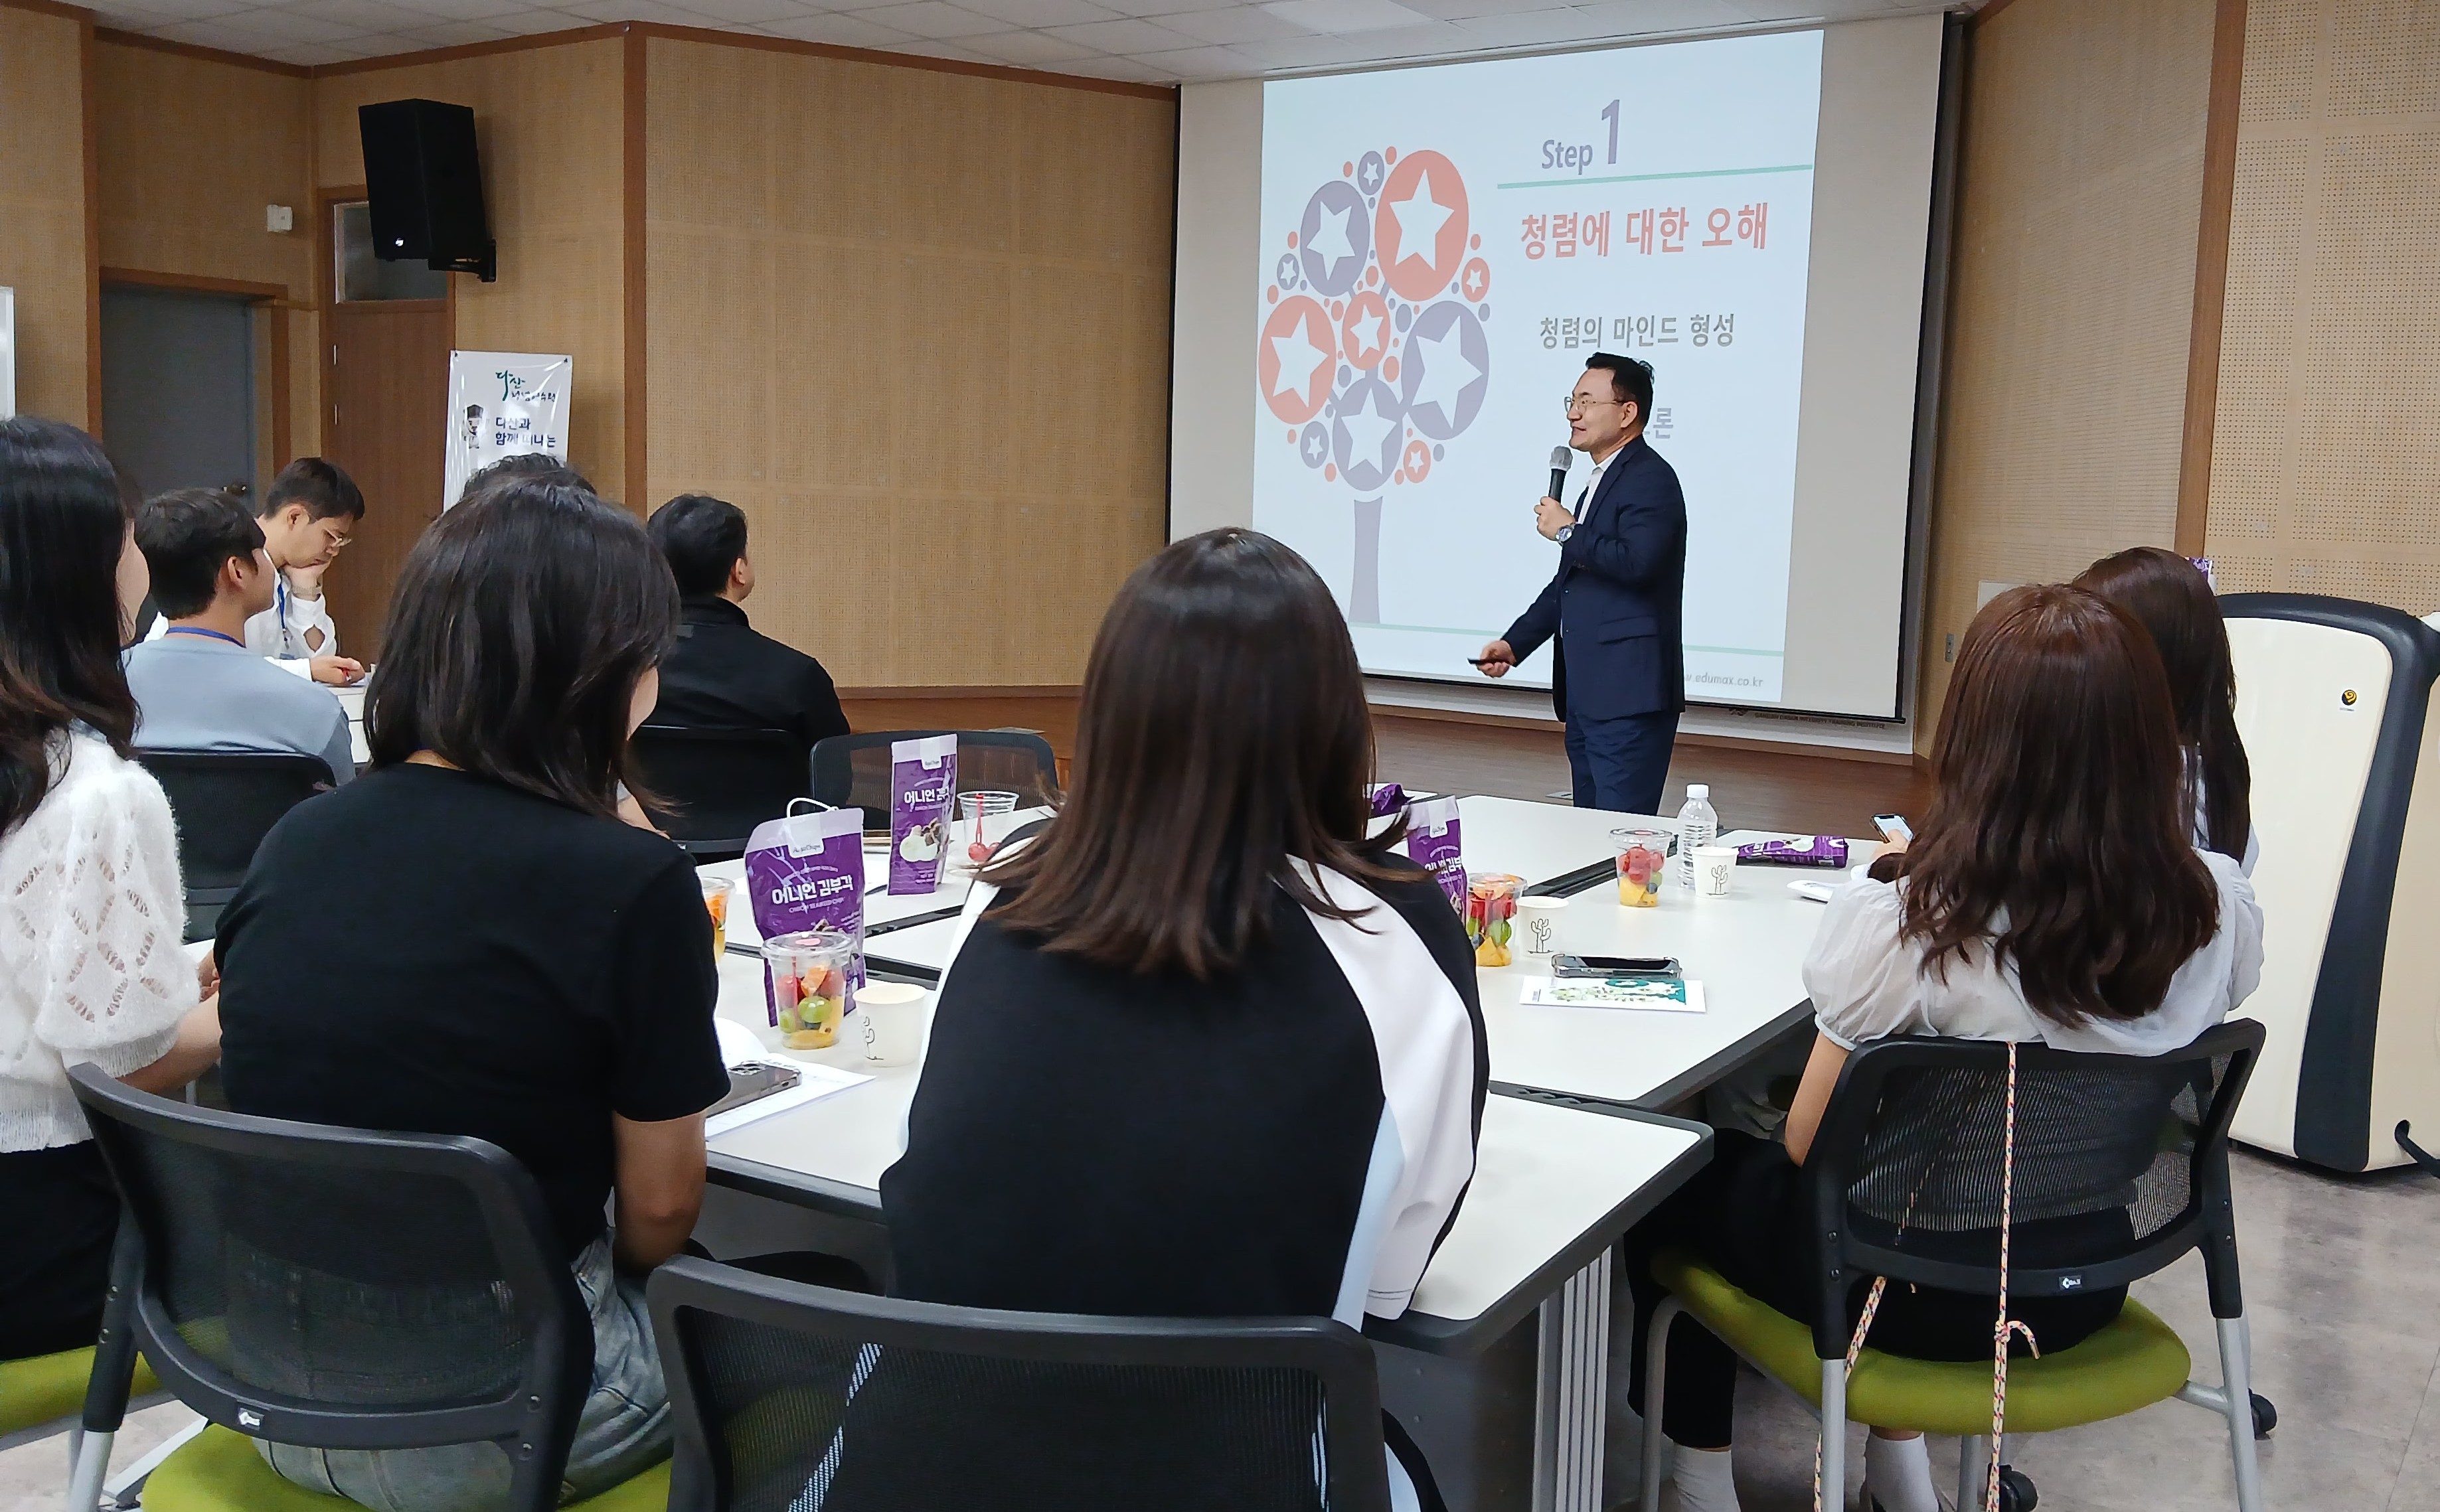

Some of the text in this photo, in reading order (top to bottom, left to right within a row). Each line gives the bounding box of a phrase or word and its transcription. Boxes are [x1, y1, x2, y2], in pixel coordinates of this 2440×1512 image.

[1542, 99, 1620, 175] Step 1
[1520, 202, 1768, 260] 청렴에 대한 오해
[1540, 313, 1734, 349] 청렴의 마인드 형성
[1645, 408, 1674, 439] 론
[904, 788, 935, 804] 어니언
[772, 881, 818, 905] 어니언
[817, 874, 854, 897] 김부각
